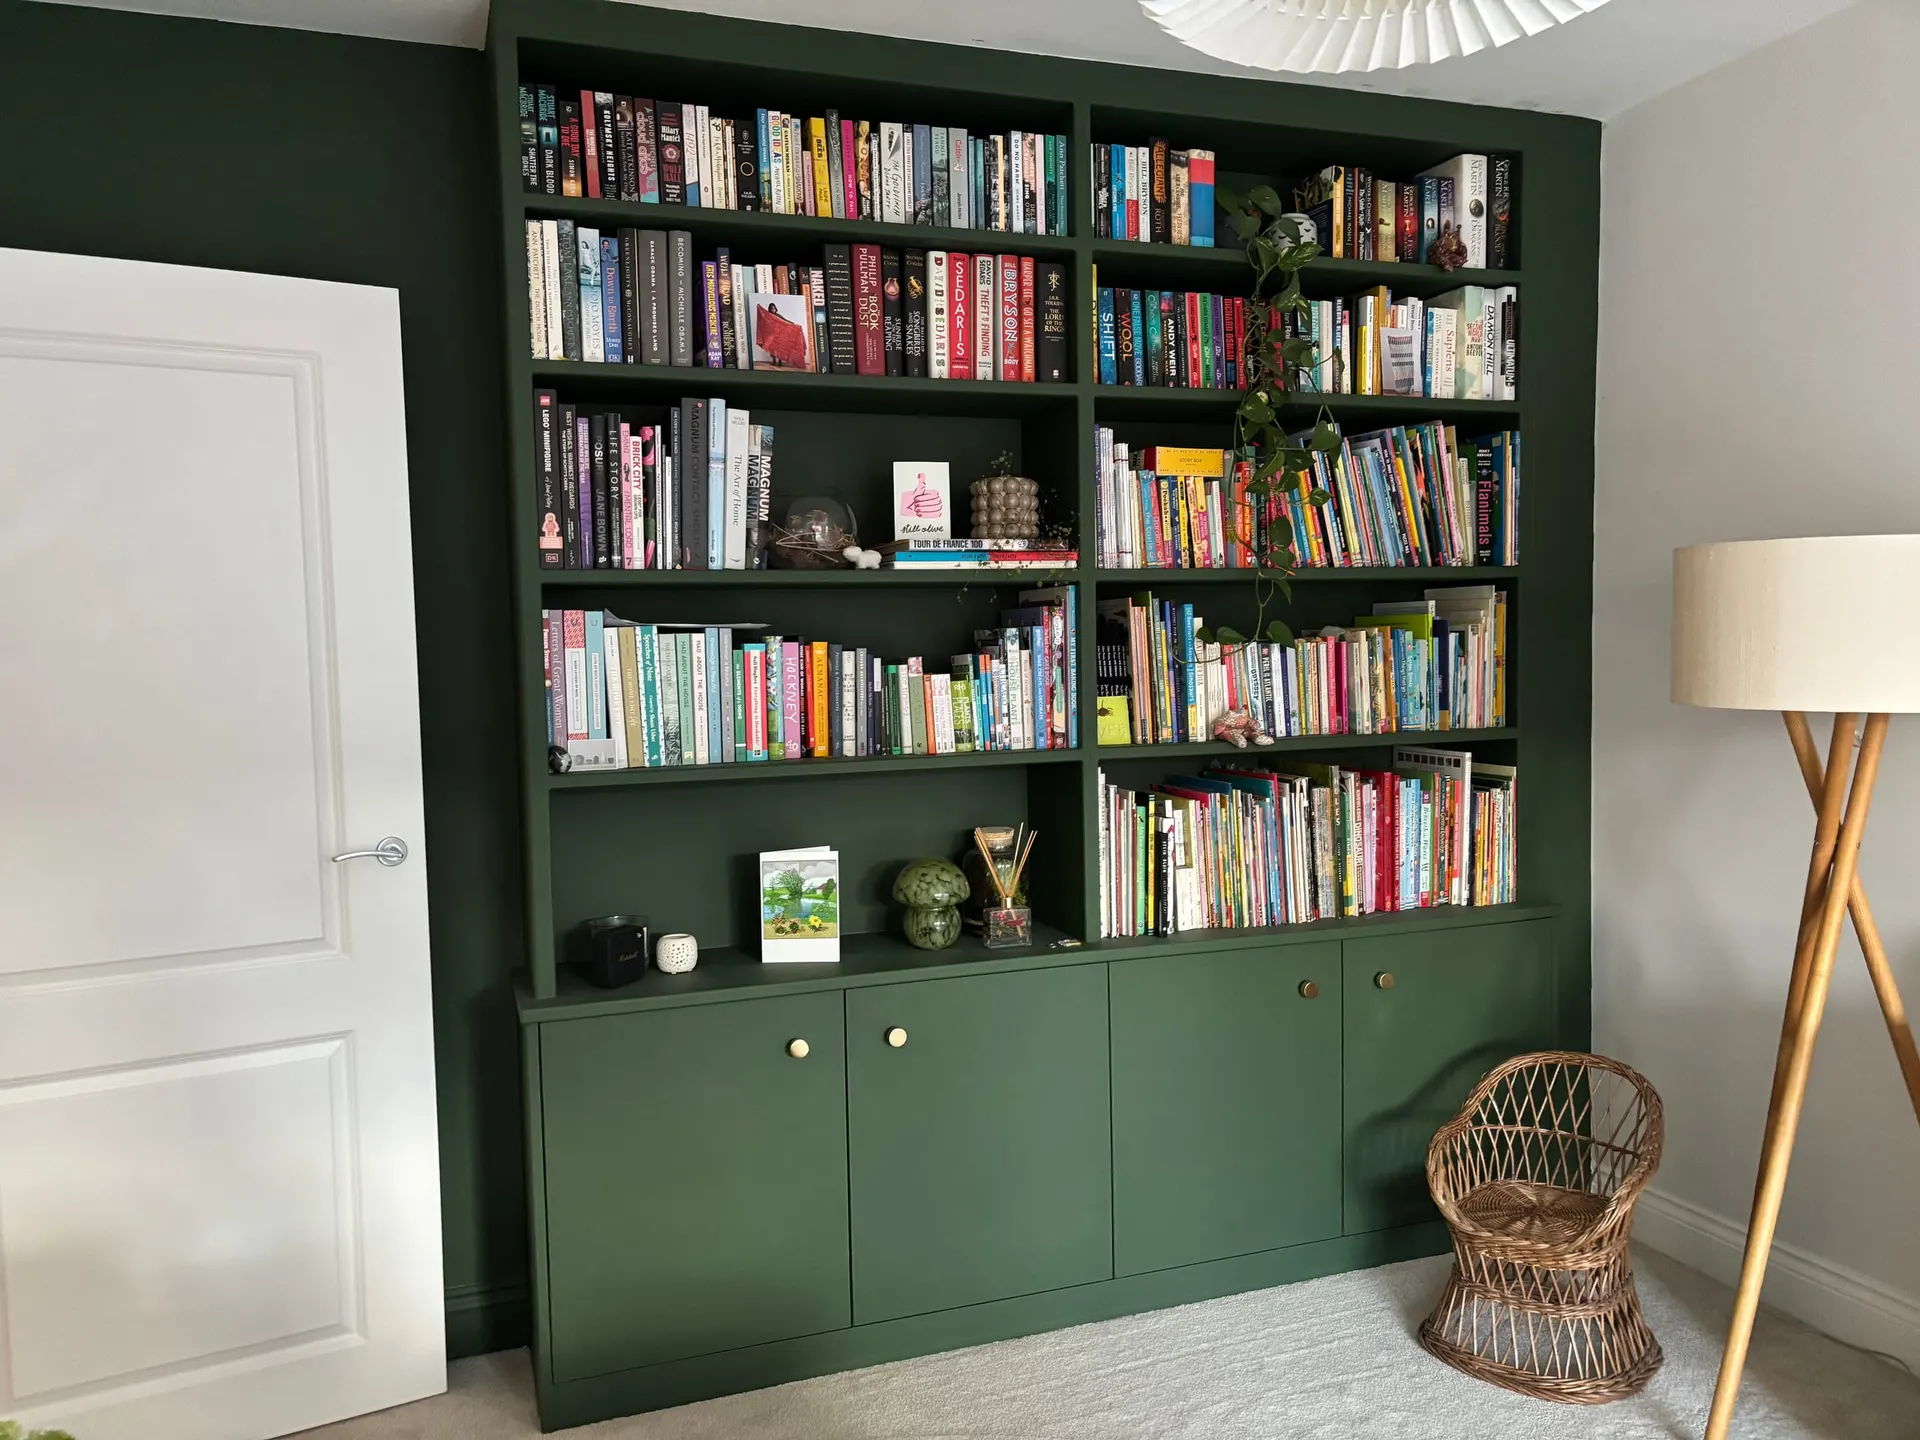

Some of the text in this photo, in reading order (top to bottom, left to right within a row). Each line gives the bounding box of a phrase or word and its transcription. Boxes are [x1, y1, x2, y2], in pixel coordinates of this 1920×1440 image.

[519, 87, 528, 117] MACBRIDE
[539, 90, 547, 121] MACBRIDE
[546, 95, 555, 118] STUART
[561, 136, 570, 147] DIE
[570, 125, 580, 157] GOOD DAY
[604, 110, 615, 181] KOLYMSKY HEIGHTS
[649, 138, 657, 170] MITCHELL
[771, 115, 781, 163] GOOD IDEAS
[1014, 140, 1019, 148] DO
[545, 150, 554, 193] DARK BLOOD
[627, 153, 636, 193] ATKINSON
[1156, 146, 1165, 199] ALLEGIANT
[1495, 161, 1504, 197] MARTIN
[720, 255, 730, 305] WOLF ROAD
[811, 270, 825, 306] NAKED
[859, 248, 869, 293] PULLMAN
[868, 256, 876, 287] PHILIP
[607, 267, 617, 333] Down Earth
[707, 279, 716, 311] MARVELLOUS
[858, 298, 868, 328] DUST
[869, 295, 878, 330] BOOK
[955, 262, 965, 356] SEDARIS
[1004, 268, 1018, 342] BRYSON
[591, 315, 601, 349] MOYES
[722, 321, 730, 356] ROBERTS
[884, 316, 892, 351] REAPING
[981, 289, 990, 357] THEFT FINDING
[1023, 261, 1033, 373] HARPER LEE GO SET WATCHMAN
[1103, 312, 1115, 360] SHIFT
[1121, 312, 1132, 362] WOOL
[1224, 299, 1234, 360] RICHARD OSMAN
[1486, 305, 1494, 349] DAMON
[1444, 330, 1454, 372] Sapiens
[1505, 339, 1516, 383] ULTIMATUM
[691, 404, 699, 454] MAGNUM
[543, 430, 552, 472] MINIFIGURE
[609, 430, 619, 500] LIFE STORY
[632, 441, 641, 491] BRICK CITY
[732, 455, 742, 526] The Art of Home
[747, 455, 759, 520] MAGNUM
[759, 455, 771, 522] MAGNUM
[596, 489, 606, 552] JANE BOWN
[901, 524, 920, 533] still
[1478, 481, 1492, 545] Flanimals
[943, 540, 969, 548] FRANCE
[971, 540, 983, 548] 100
[644, 634, 652, 659] Speeches
[1070, 637, 1075, 647] MY
[551, 621, 564, 728] Letters of Great Women
[784, 657, 798, 723] HOCKNEY
[816, 658, 824, 701] ALMANAC
[1250, 669, 1259, 700] ODYSSEY
[1262, 657, 1272, 702] PERIL ATLANTIC
[953, 697, 963, 725] PLACES
[1010, 694, 1018, 721] PLANT
